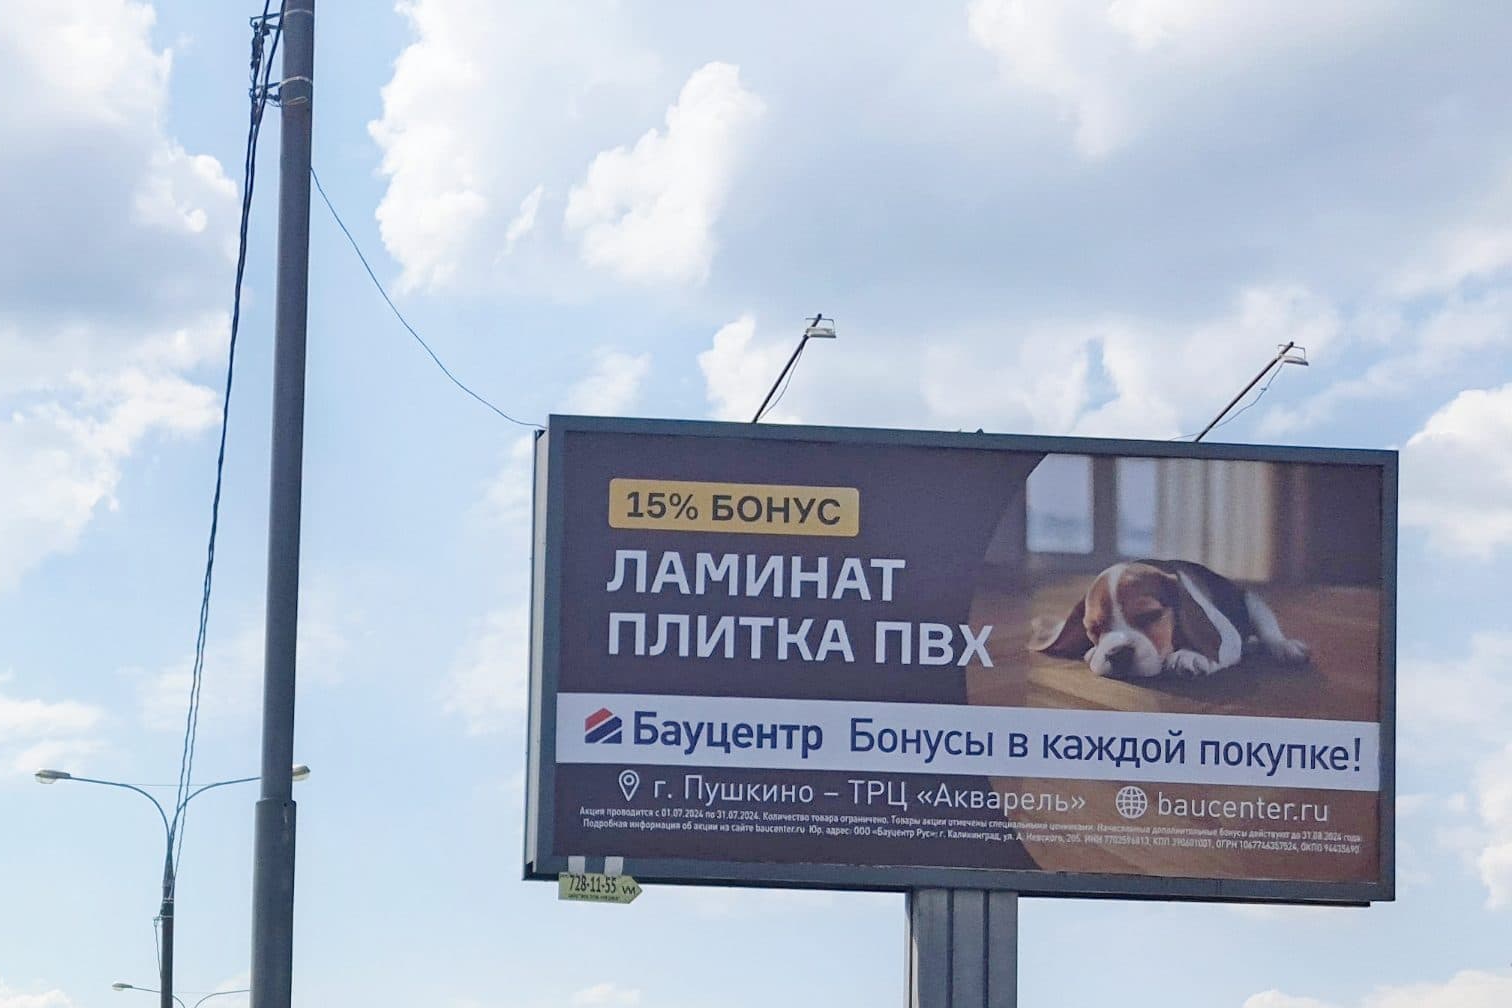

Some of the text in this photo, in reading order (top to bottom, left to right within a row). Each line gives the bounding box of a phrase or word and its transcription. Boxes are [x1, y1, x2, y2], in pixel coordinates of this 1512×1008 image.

[626, 491, 842, 527] 15% БОНУС
[606, 549, 906, 602] ЛАМИНАТ
[607, 612, 995, 668] ПЛИТКА ПВХ
[633, 710, 824, 757] Бауцентр
[849, 717, 1362, 776] Бонусы в каждой покупке!
[653, 780, 674, 799] г.
[684, 774, 814, 806] Пушкино
[847, 779, 909, 812] ТРЦ
[917, 782, 1088, 817] «Акварель»
[1157, 791, 1329, 822] baucenter.ru
[579, 807, 605, 817] Акция
[606, 809, 654, 818] проводится
[661, 809, 704, 819] 01.07.2024
[762, 813, 809, 822] Количество
[811, 815, 839, 824] товара
[891, 817, 920, 827] Товары
[583, 818, 628, 829] Подробная
[630, 821, 680, 831] информация
[682, 821, 693, 830] об
[755, 824, 805, 834] baucenter.ru
[569, 874, 617, 894] 728-11-55
